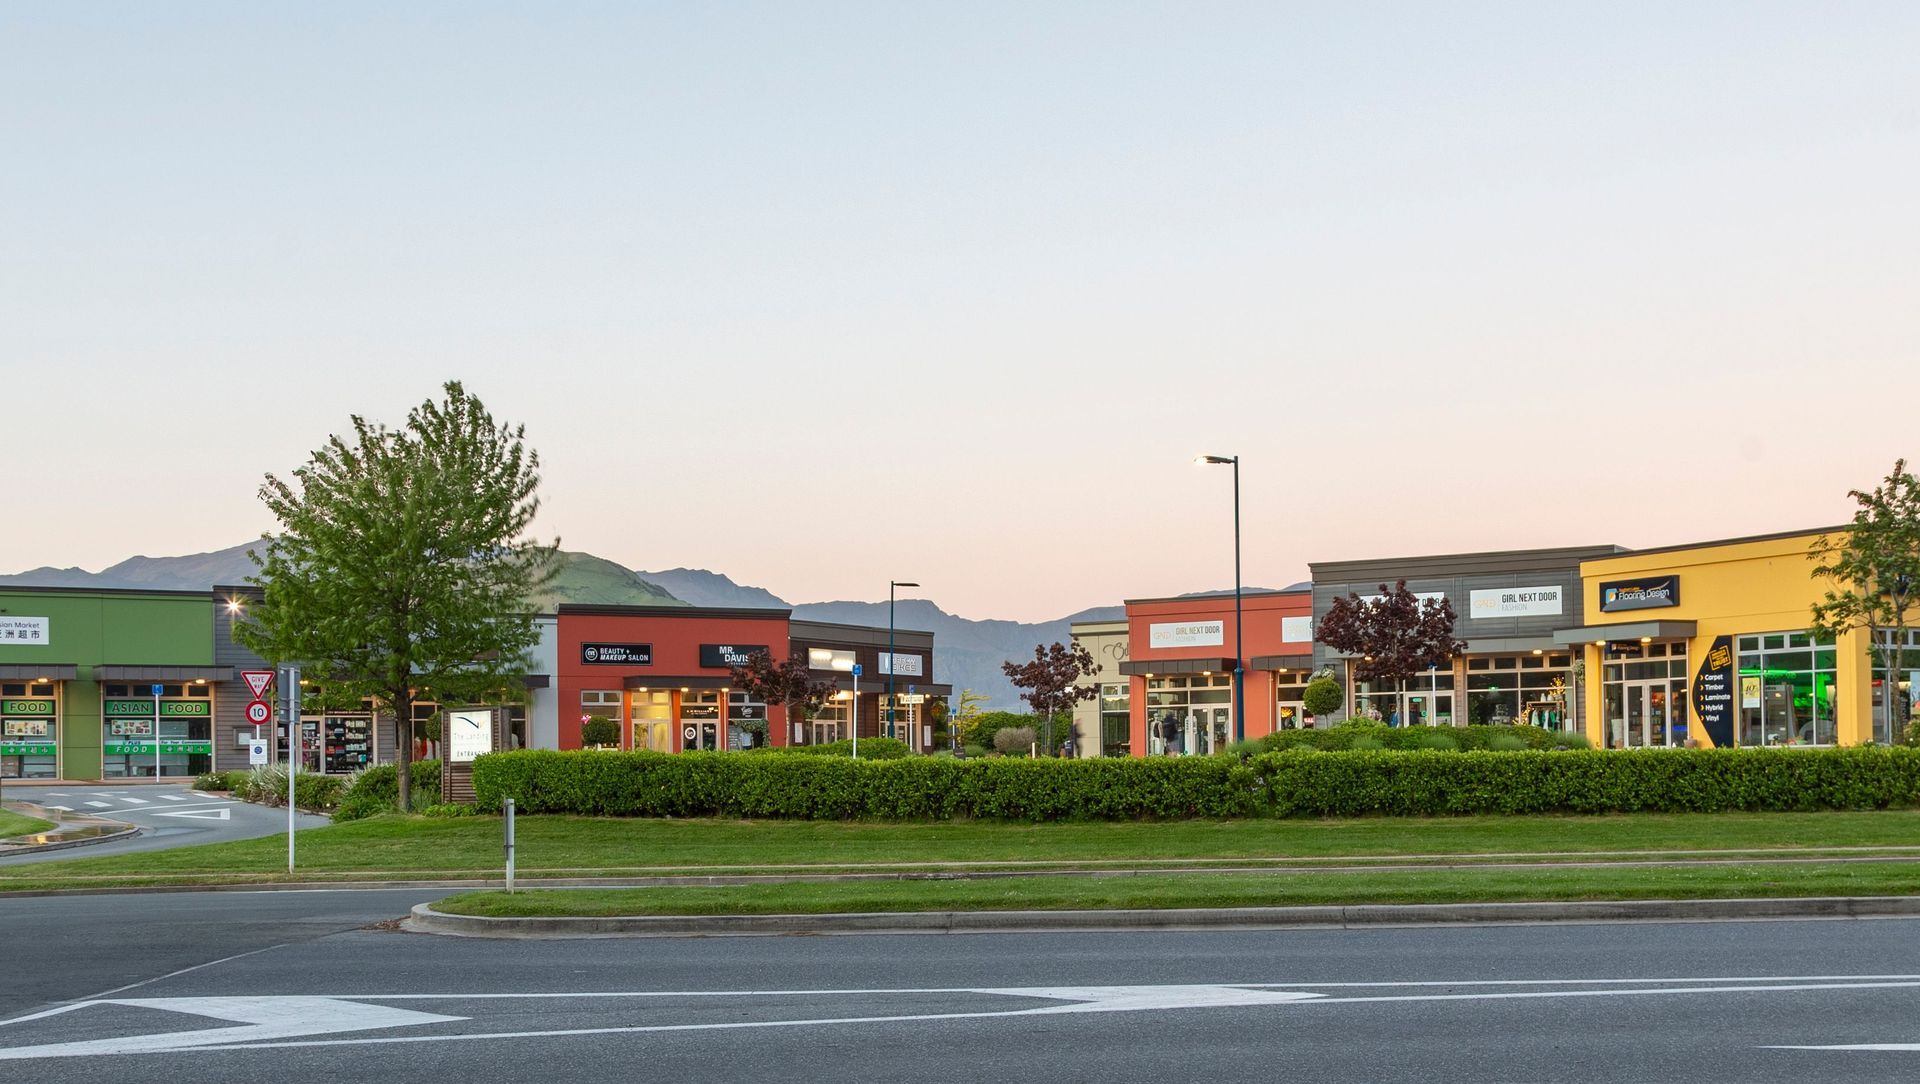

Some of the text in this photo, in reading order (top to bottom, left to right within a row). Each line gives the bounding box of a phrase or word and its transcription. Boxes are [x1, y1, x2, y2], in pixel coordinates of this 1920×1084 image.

[1501, 592, 1558, 603] GIRL NEXT DOOR
[1618, 591, 1646, 601] Flooring
[1646, 589, 1670, 599] Design
[1501, 603, 1528, 612] FASHION
[1175, 625, 1220, 635] GIRL NEXT DOOR
[719, 646, 735, 654] MR.
[10, 702, 47, 712] FOOD
[112, 703, 202, 713] ASIAN FOOD
[1705, 704, 1724, 712] Hybrid
[253, 708, 264, 717] 10
